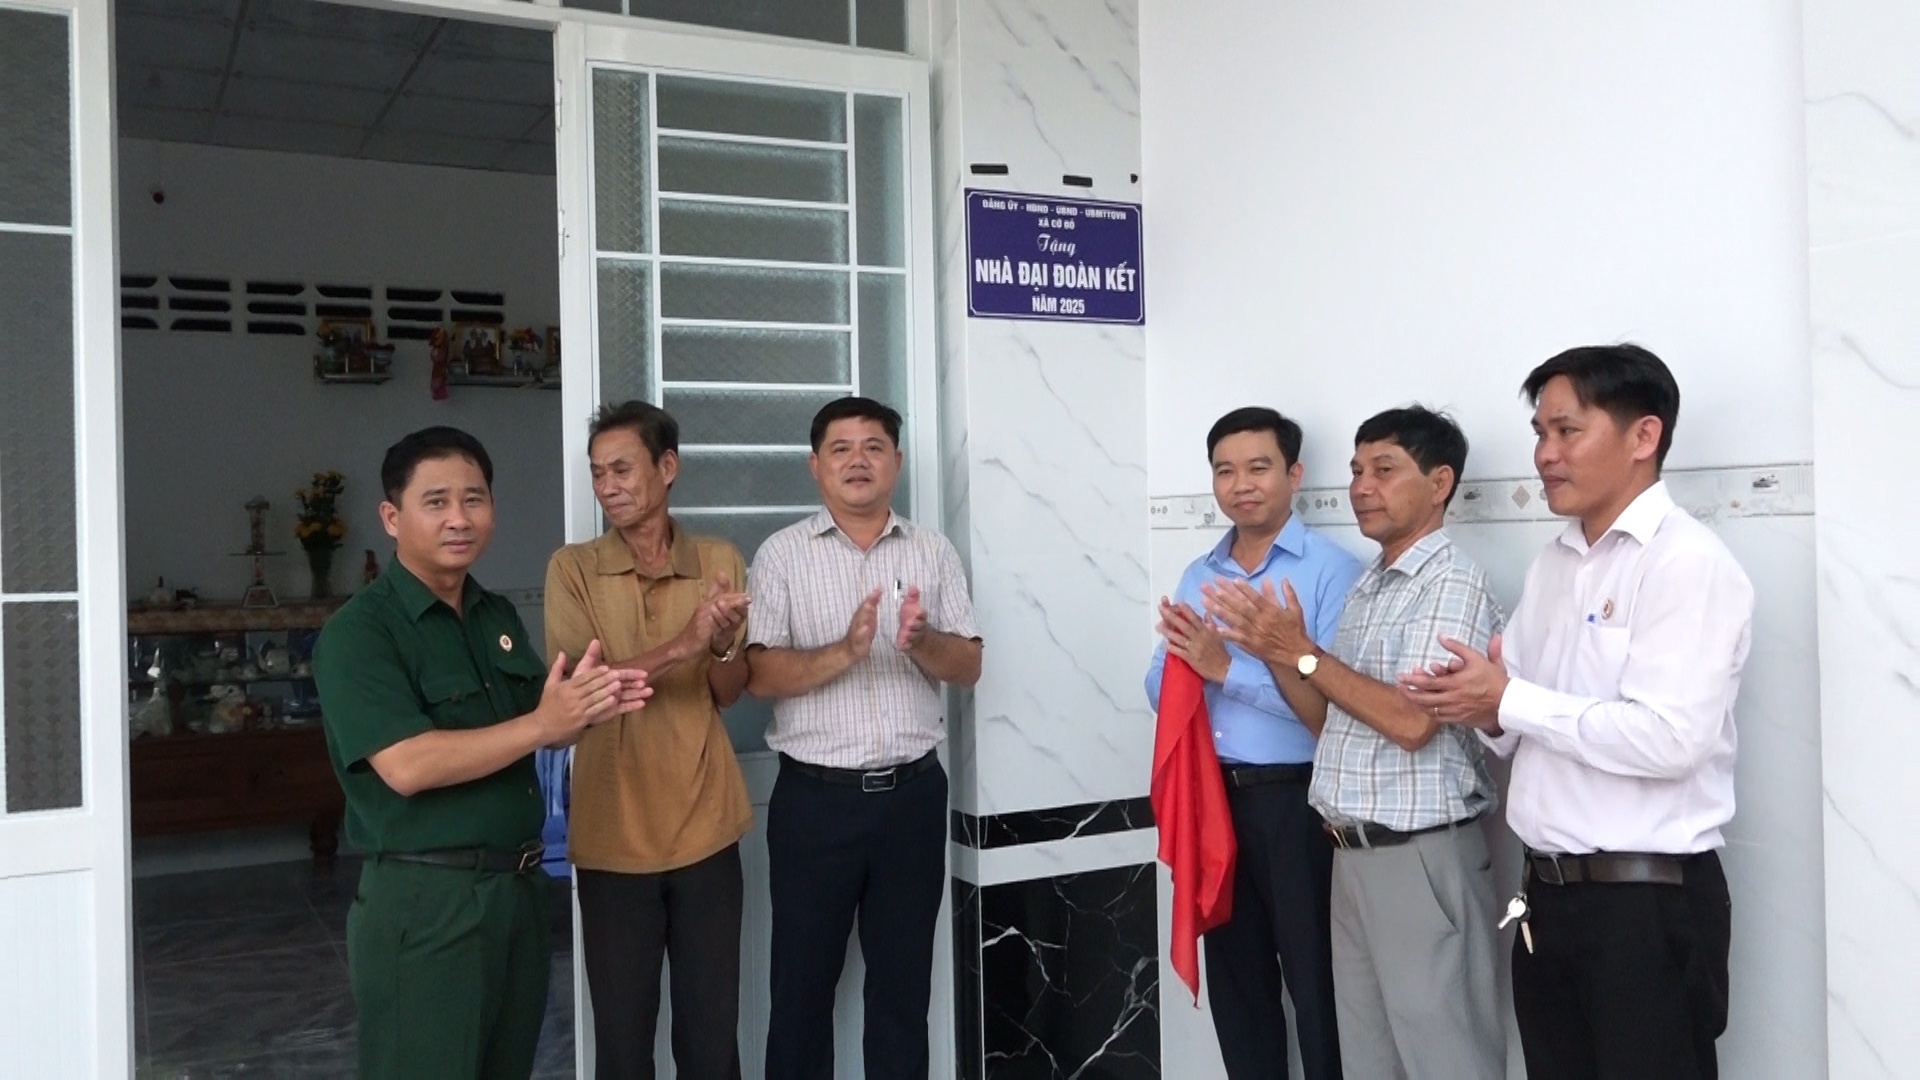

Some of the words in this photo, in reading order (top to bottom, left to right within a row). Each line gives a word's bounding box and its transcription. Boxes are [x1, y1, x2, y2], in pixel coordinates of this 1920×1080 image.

[1056, 205, 1078, 216] UBND
[1037, 233, 1076, 257] Tặng
[974, 255, 1014, 284] NHÀ
[1018, 261, 1048, 292] ĐẠI
[1052, 260, 1101, 291] ĐOÀN
[1105, 260, 1137, 293] KẾT
[1031, 293, 1058, 313] NĂM
[1059, 299, 1085, 315] 2025
